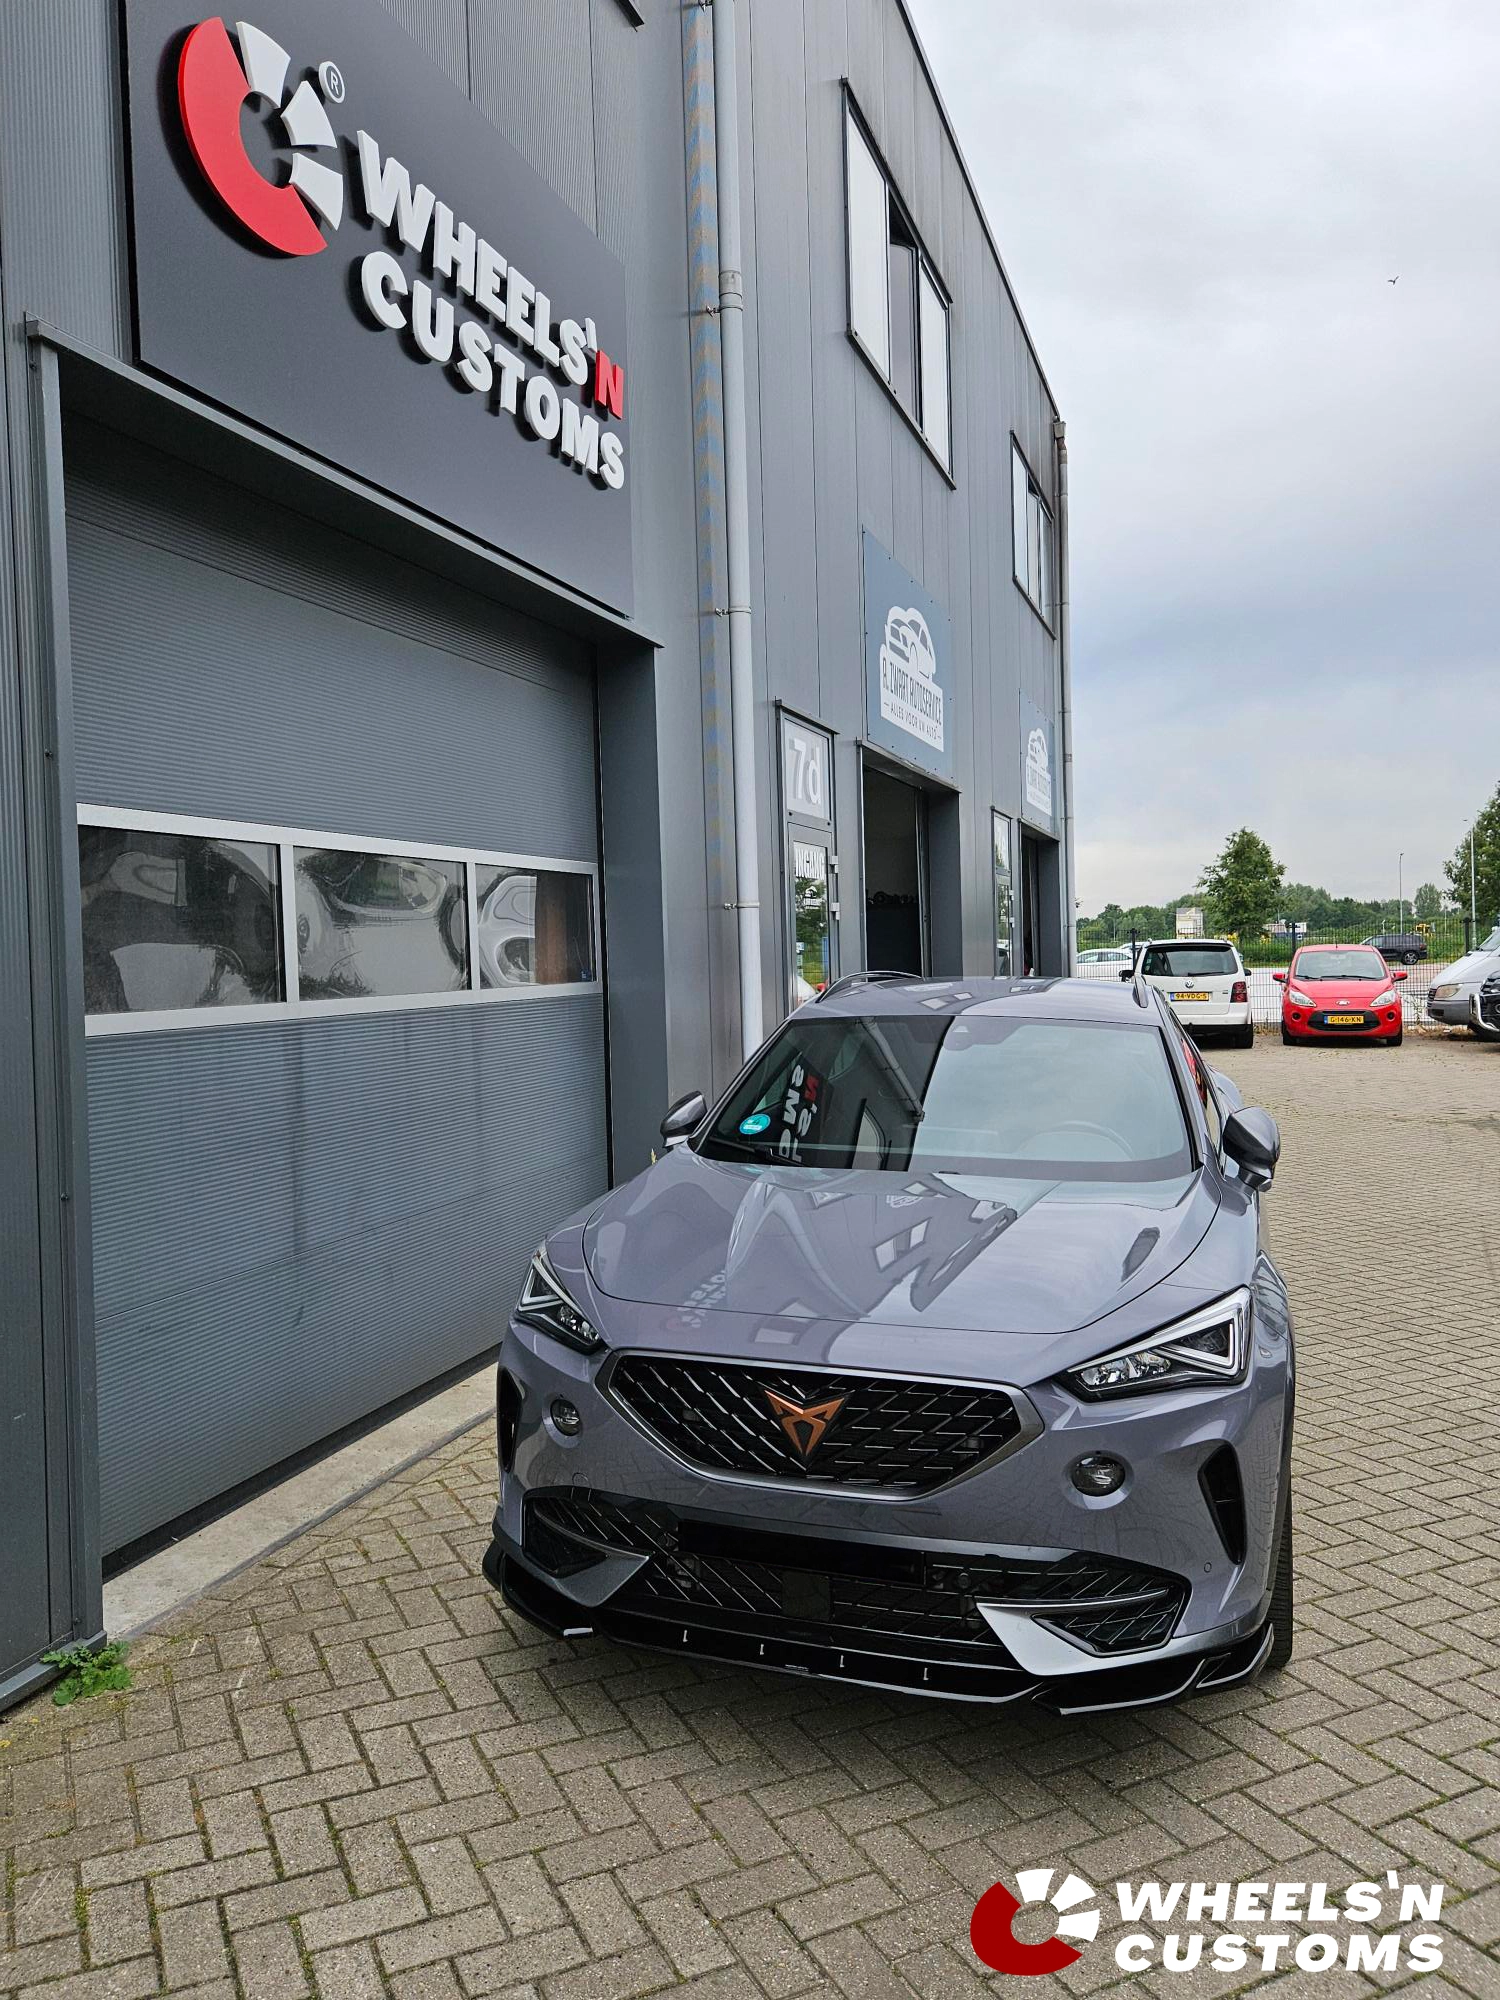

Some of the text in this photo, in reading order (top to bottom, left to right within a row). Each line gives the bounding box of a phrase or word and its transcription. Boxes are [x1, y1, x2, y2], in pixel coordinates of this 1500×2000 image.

[357, 130, 623, 419] WHEELS'N
[361, 250, 624, 489] CUSTOMS
[890, 661, 909, 704] ZWART
[909, 676, 942, 725] AUTOSERVICE
[793, 738, 821, 804] 7d
